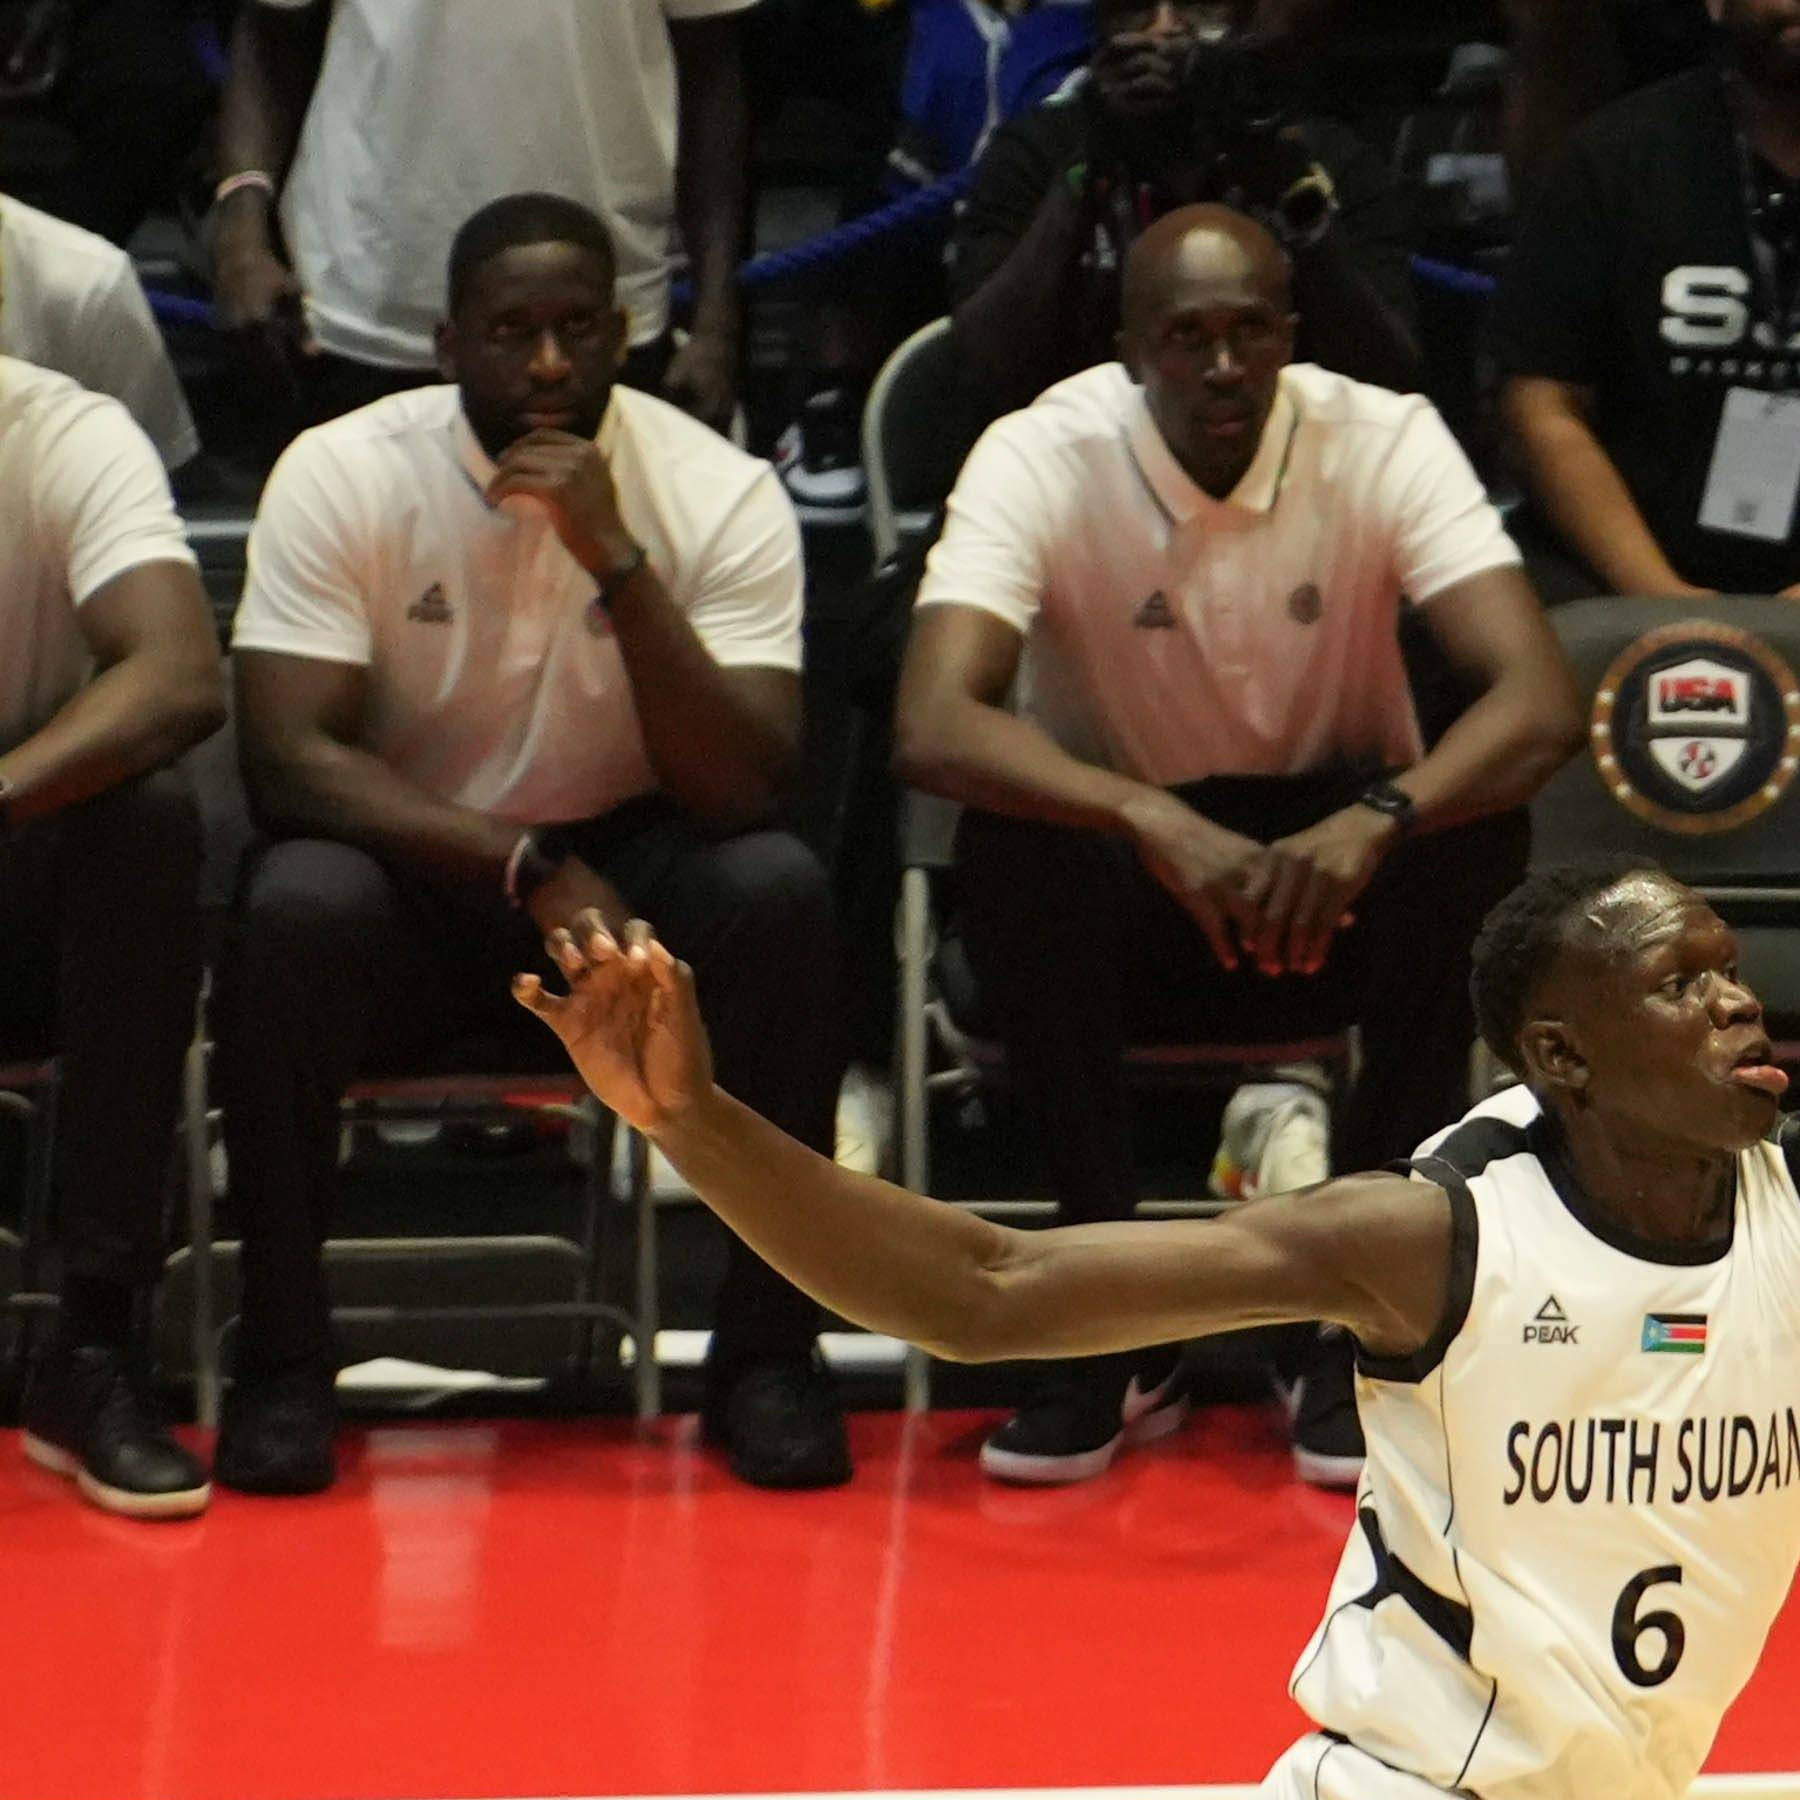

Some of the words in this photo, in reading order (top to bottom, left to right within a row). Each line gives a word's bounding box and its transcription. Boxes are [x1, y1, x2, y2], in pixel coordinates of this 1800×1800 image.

[1523, 1325, 1580, 1344] PEAK
[1503, 1417, 1660, 1506] SOUTH
[1611, 1564, 1686, 1688] 6
